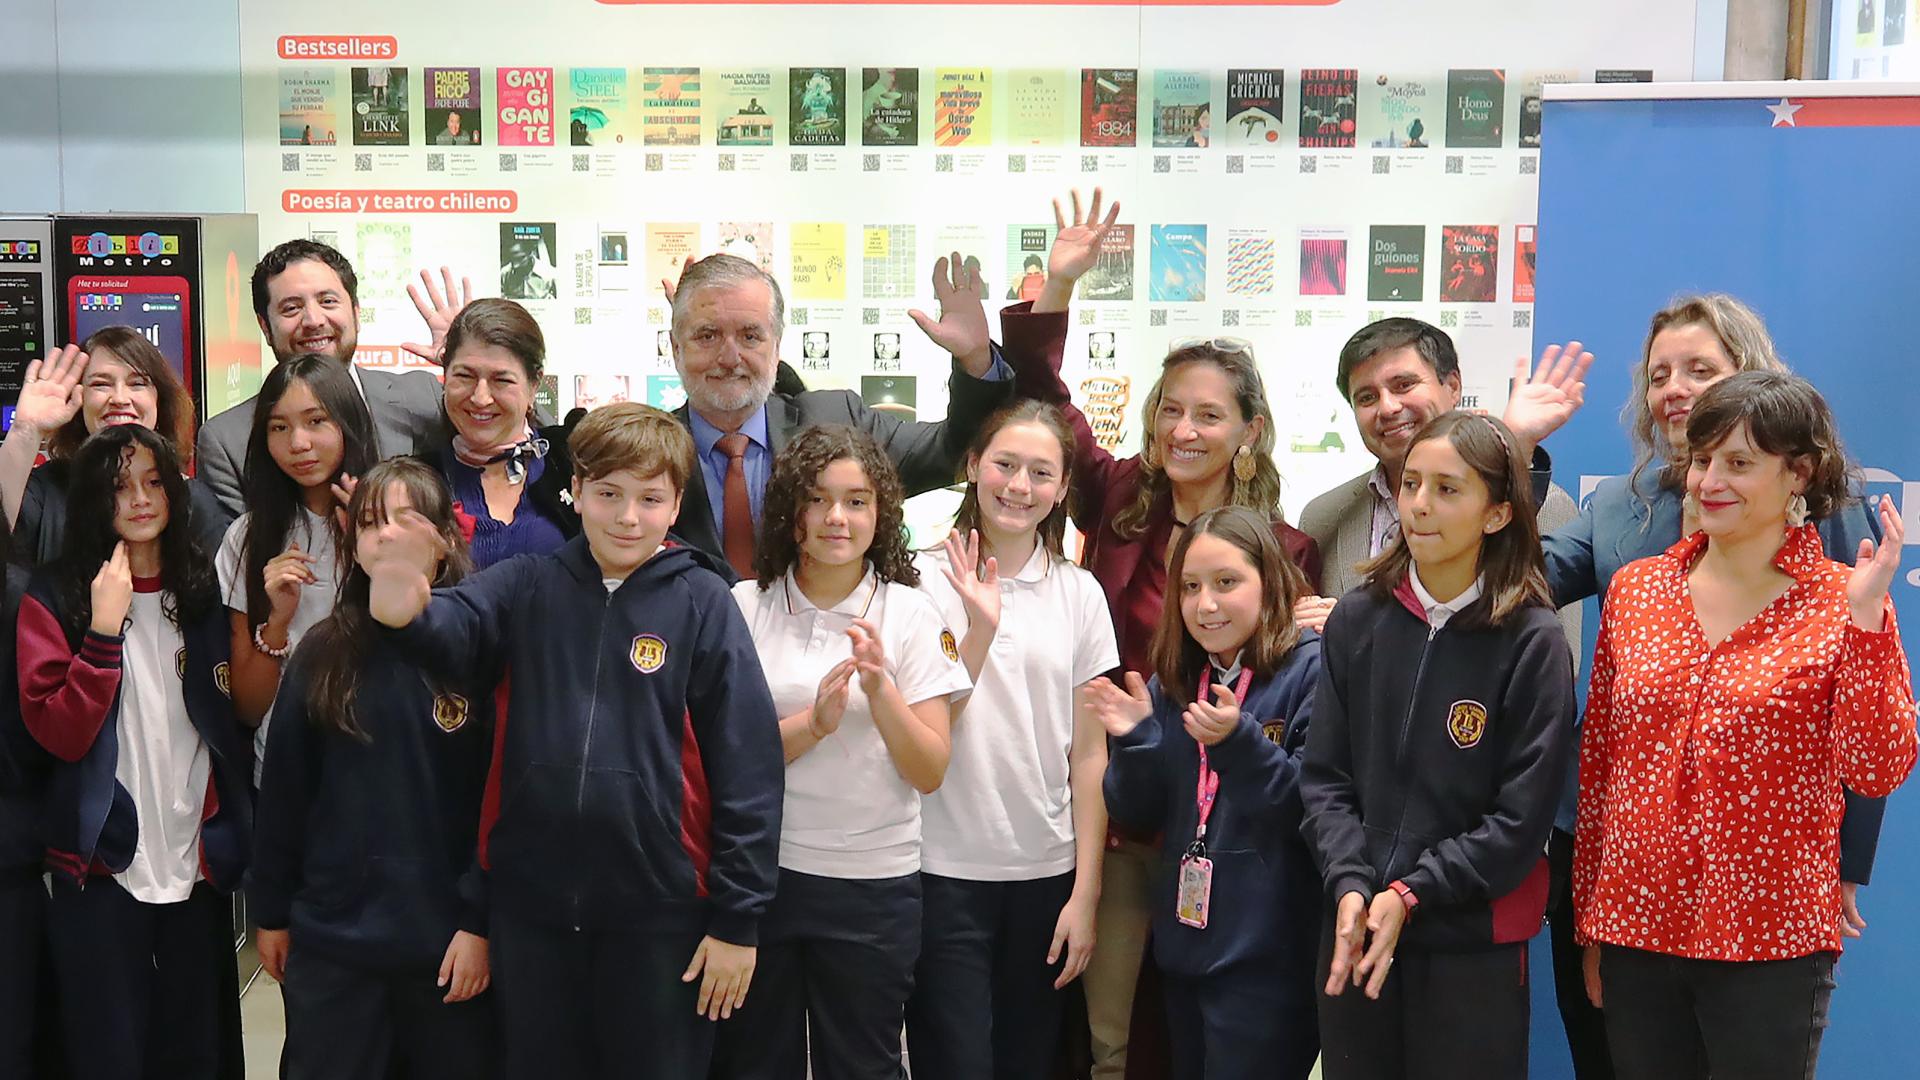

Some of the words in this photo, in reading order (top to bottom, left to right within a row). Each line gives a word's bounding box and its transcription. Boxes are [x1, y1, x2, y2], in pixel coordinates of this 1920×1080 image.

[284, 38, 392, 57] Bestsellers
[434, 71, 469, 85] PADRE
[506, 70, 548, 88] GAY
[574, 70, 622, 84] Danielle
[1237, 72, 1273, 85] MICHAEL
[434, 84, 464, 99] RICO
[576, 84, 620, 98] STEEL
[1230, 84, 1281, 99] CRICHTON
[1305, 83, 1352, 96] FIERAS
[1458, 96, 1493, 109] Homo
[501, 107, 550, 125] GAN
[1461, 109, 1489, 121] Deus
[363, 120, 400, 132] LINK
[1096, 120, 1132, 136] 1984
[523, 125, 551, 143] TE
[289, 191, 352, 210] Poesía
[357, 196, 368, 213] y
[374, 193, 435, 210] teatro
[440, 191, 511, 210] chileno
[74, 237, 174, 254] Biblio
[1375, 239, 1397, 252] Dos
[1453, 245, 1487, 253] SORDO
[79, 257, 172, 266] Metro
[1374, 251, 1420, 266] guiones
[92, 280, 100, 288] tu
[100, 279, 129, 288] solicitud
